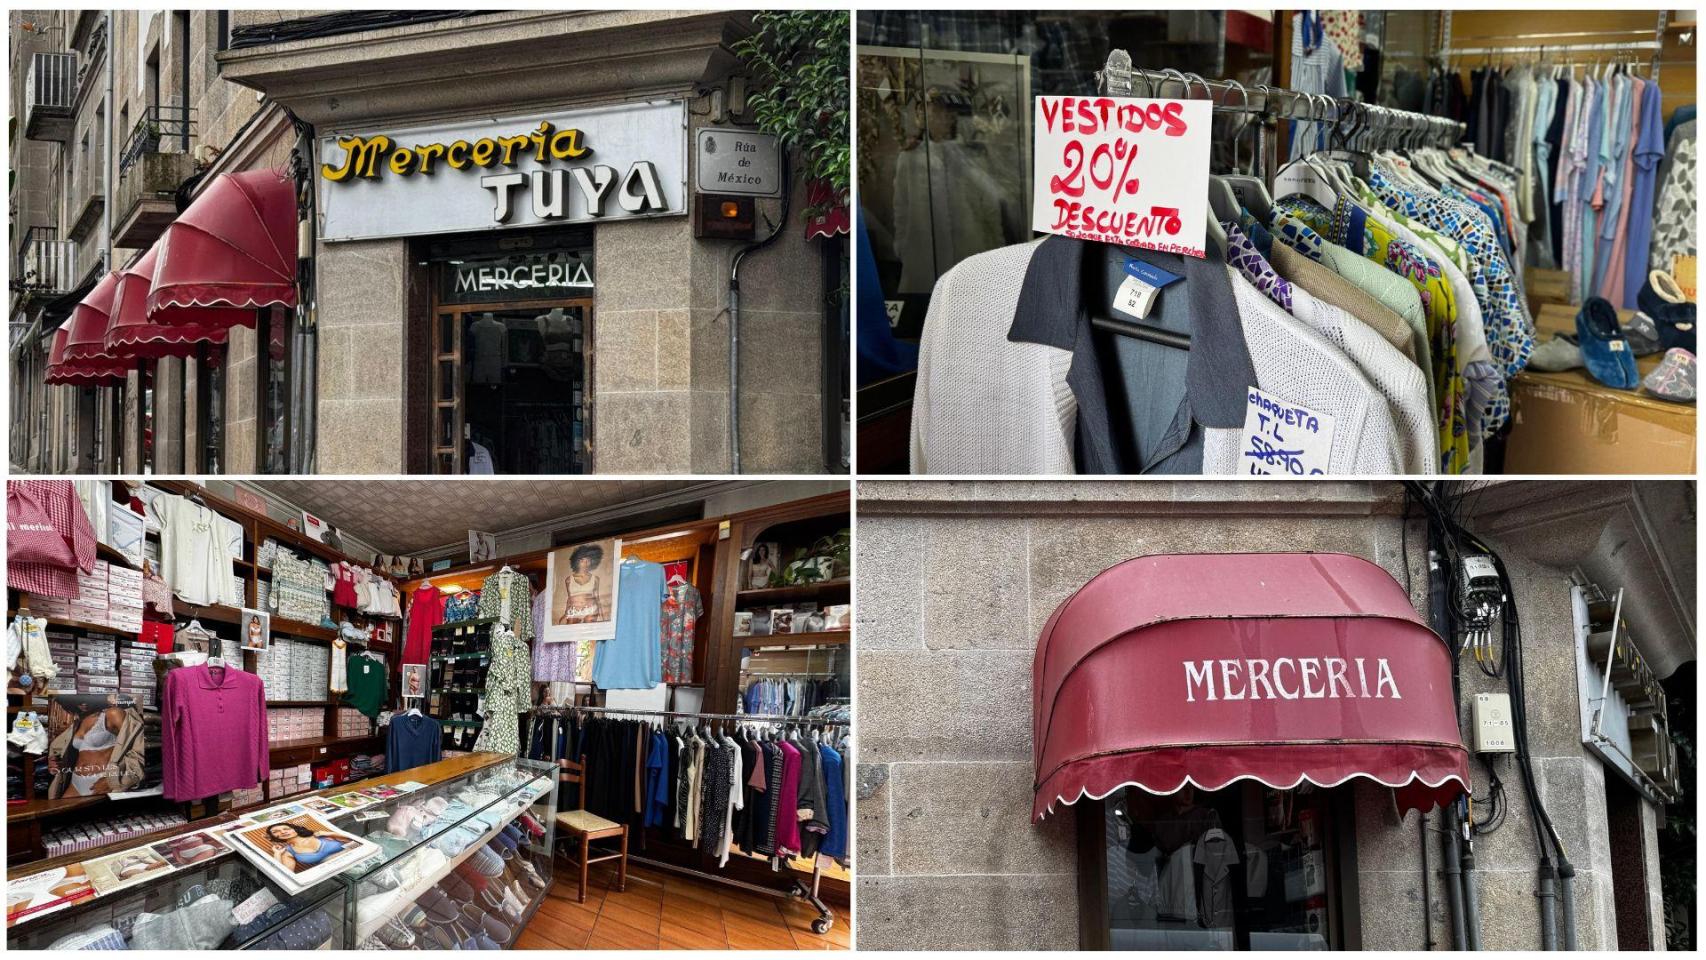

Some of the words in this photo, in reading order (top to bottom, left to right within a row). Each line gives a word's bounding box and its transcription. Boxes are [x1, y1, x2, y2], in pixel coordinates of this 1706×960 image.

[1041, 97, 1188, 137] VESTIDOS
[734, 141, 756, 153] Rúa
[738, 157, 751, 168] de
[717, 171, 762, 185] México
[1050, 137, 1140, 204] 20%
[480, 161, 668, 223] TUYA
[1051, 198, 1182, 238] DESCUENTO
[1157, 243, 1169, 252] EN
[1182, 657, 1402, 702] MERCERIA
